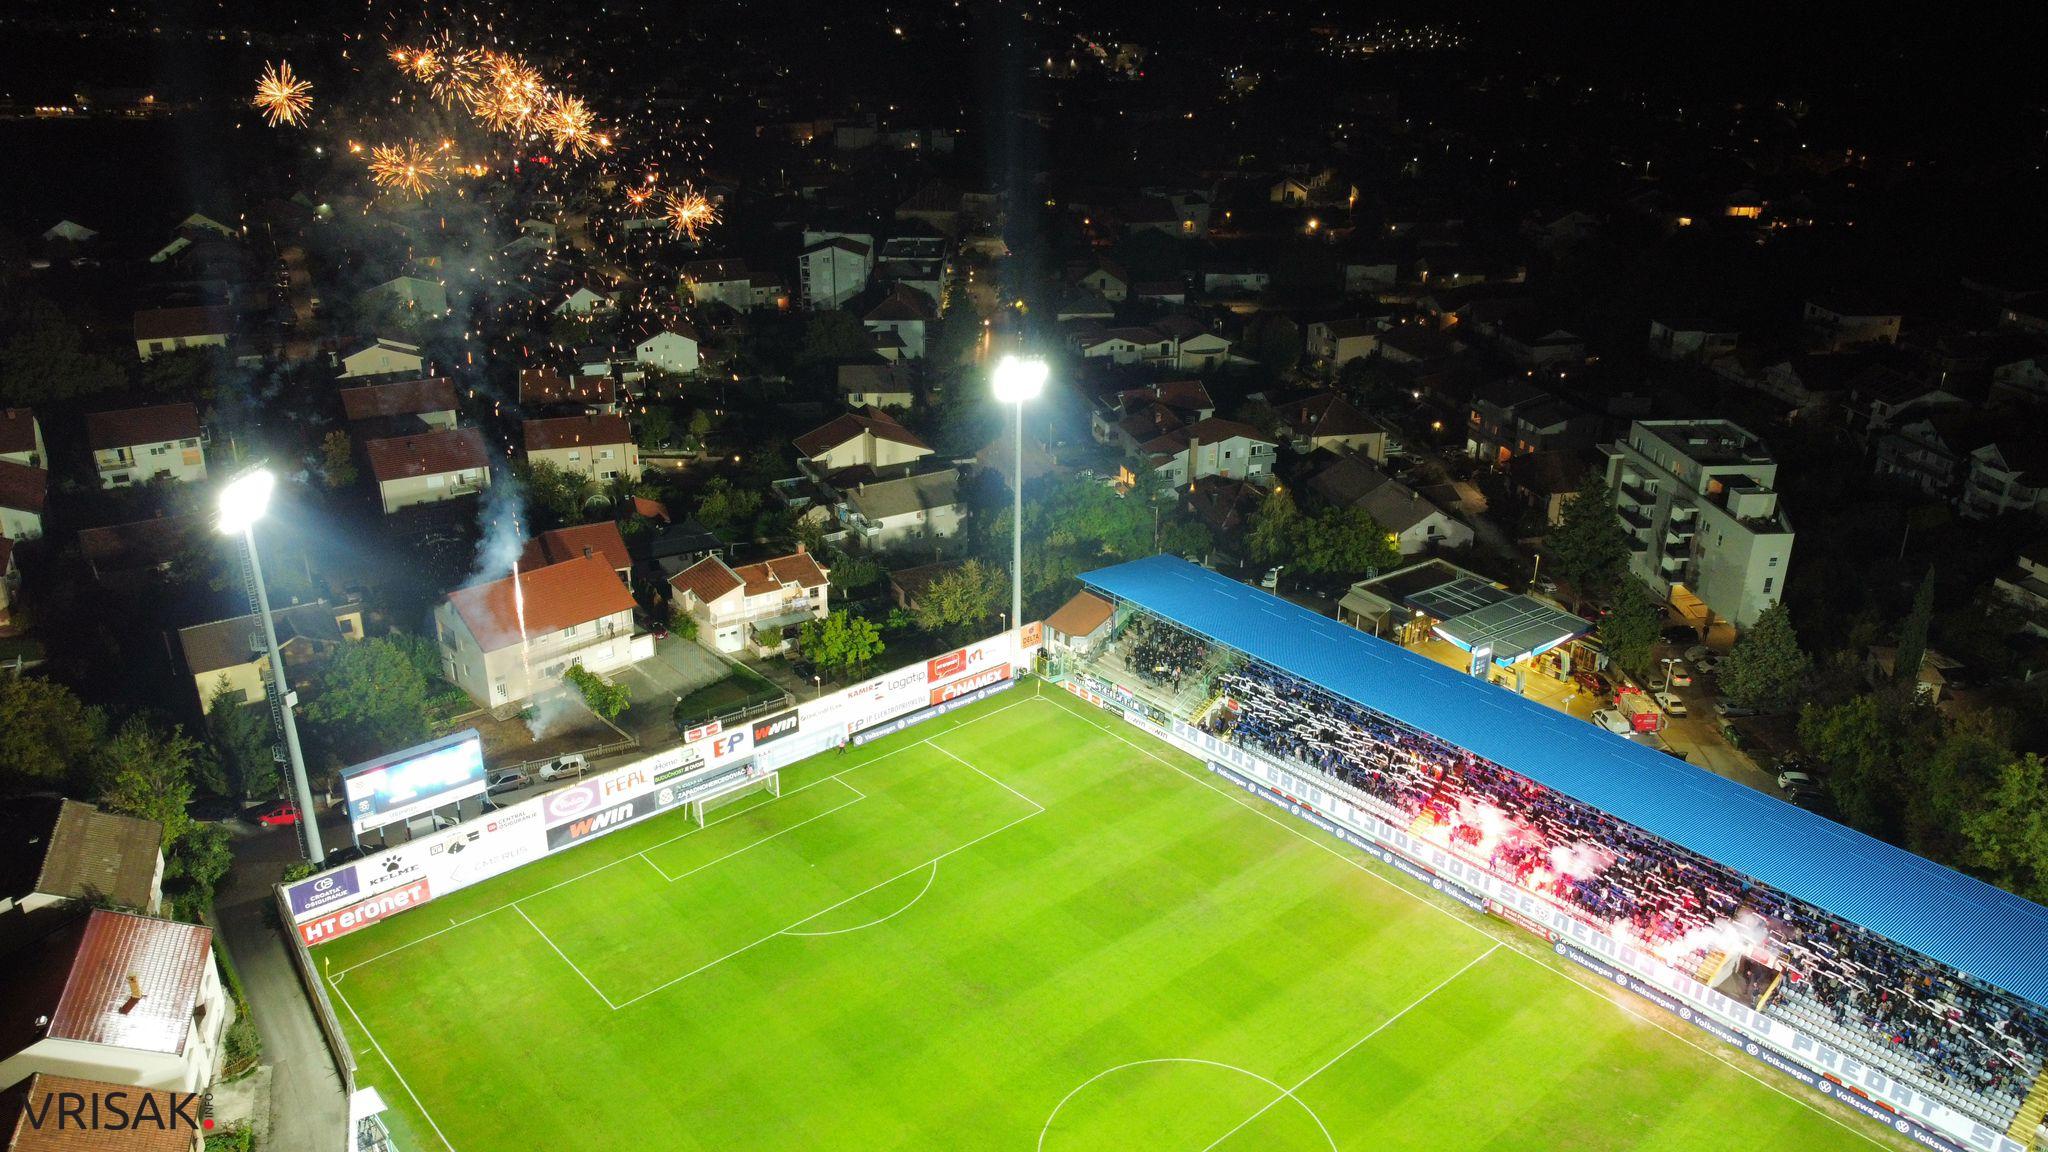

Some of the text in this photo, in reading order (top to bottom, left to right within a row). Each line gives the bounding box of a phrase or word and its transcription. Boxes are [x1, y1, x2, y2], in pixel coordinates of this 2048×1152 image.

[1216, 767, 1247, 787] Volkswagen
[1257, 789, 1289, 809] Volkswagen
[1301, 811, 1334, 832] Volkswagen
[1346, 834, 1381, 857] Volkswagen
[370, 864, 420, 887] KELME
[1394, 859, 1431, 883] Volkswagen
[305, 890, 348, 909] OSIGURANJE
[310, 887, 342, 902] CROATIA
[1444, 885, 1482, 910] Volkswagen
[1568, 950, 1613, 978] Volkswagen
[1630, 982, 1676, 1010] Volkswagen
[1694, 1016, 1743, 1047] Volkswagen
[1762, 1052, 1814, 1083] Volkswagen
[1836, 1089, 1891, 1123] Volkswagen
